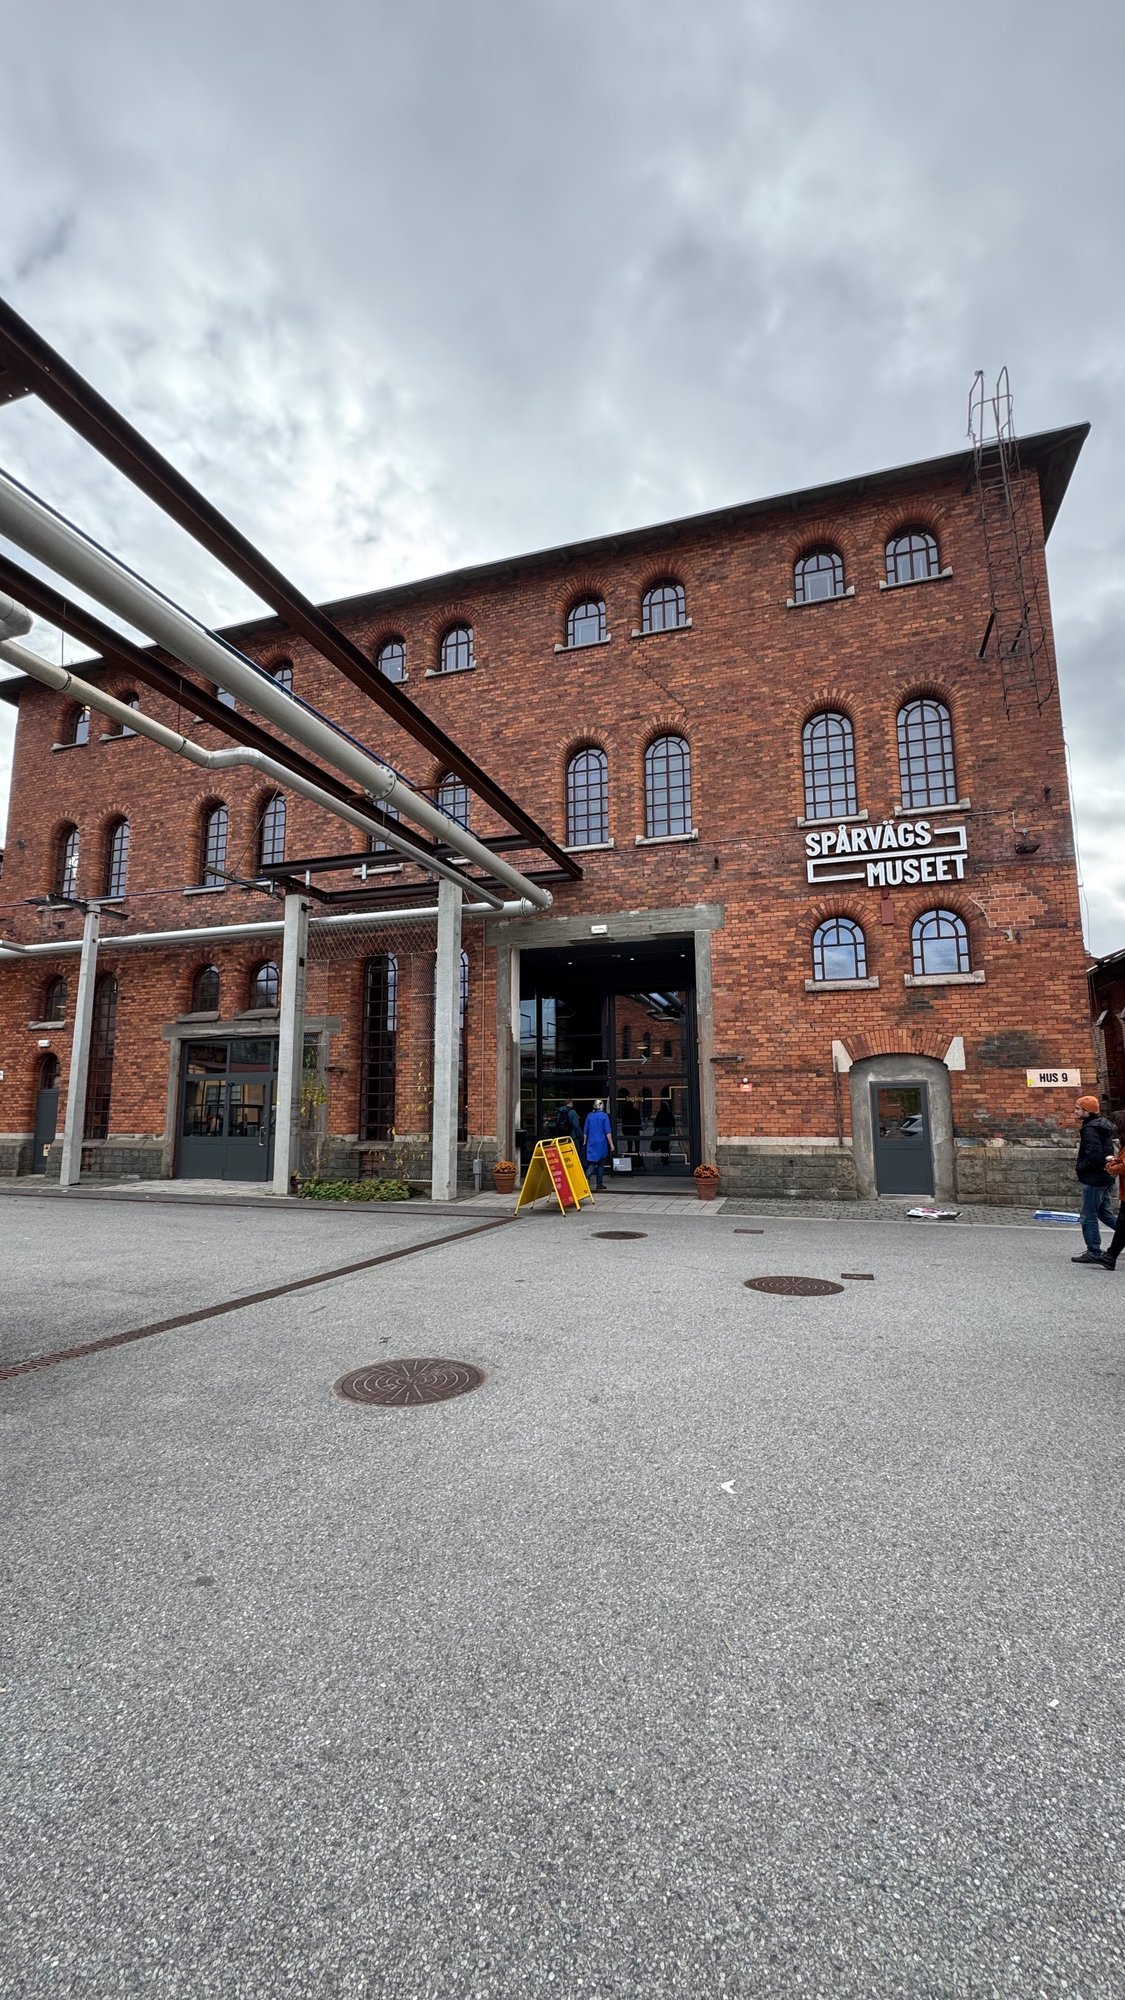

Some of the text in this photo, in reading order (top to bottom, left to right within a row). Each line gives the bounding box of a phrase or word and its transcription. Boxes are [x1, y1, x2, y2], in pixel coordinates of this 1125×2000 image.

[805, 820, 932, 857] SPÅRVÄGS
[866, 853, 968, 888] MUSEET
[1039, 1072, 1068, 1083] HUS 9
